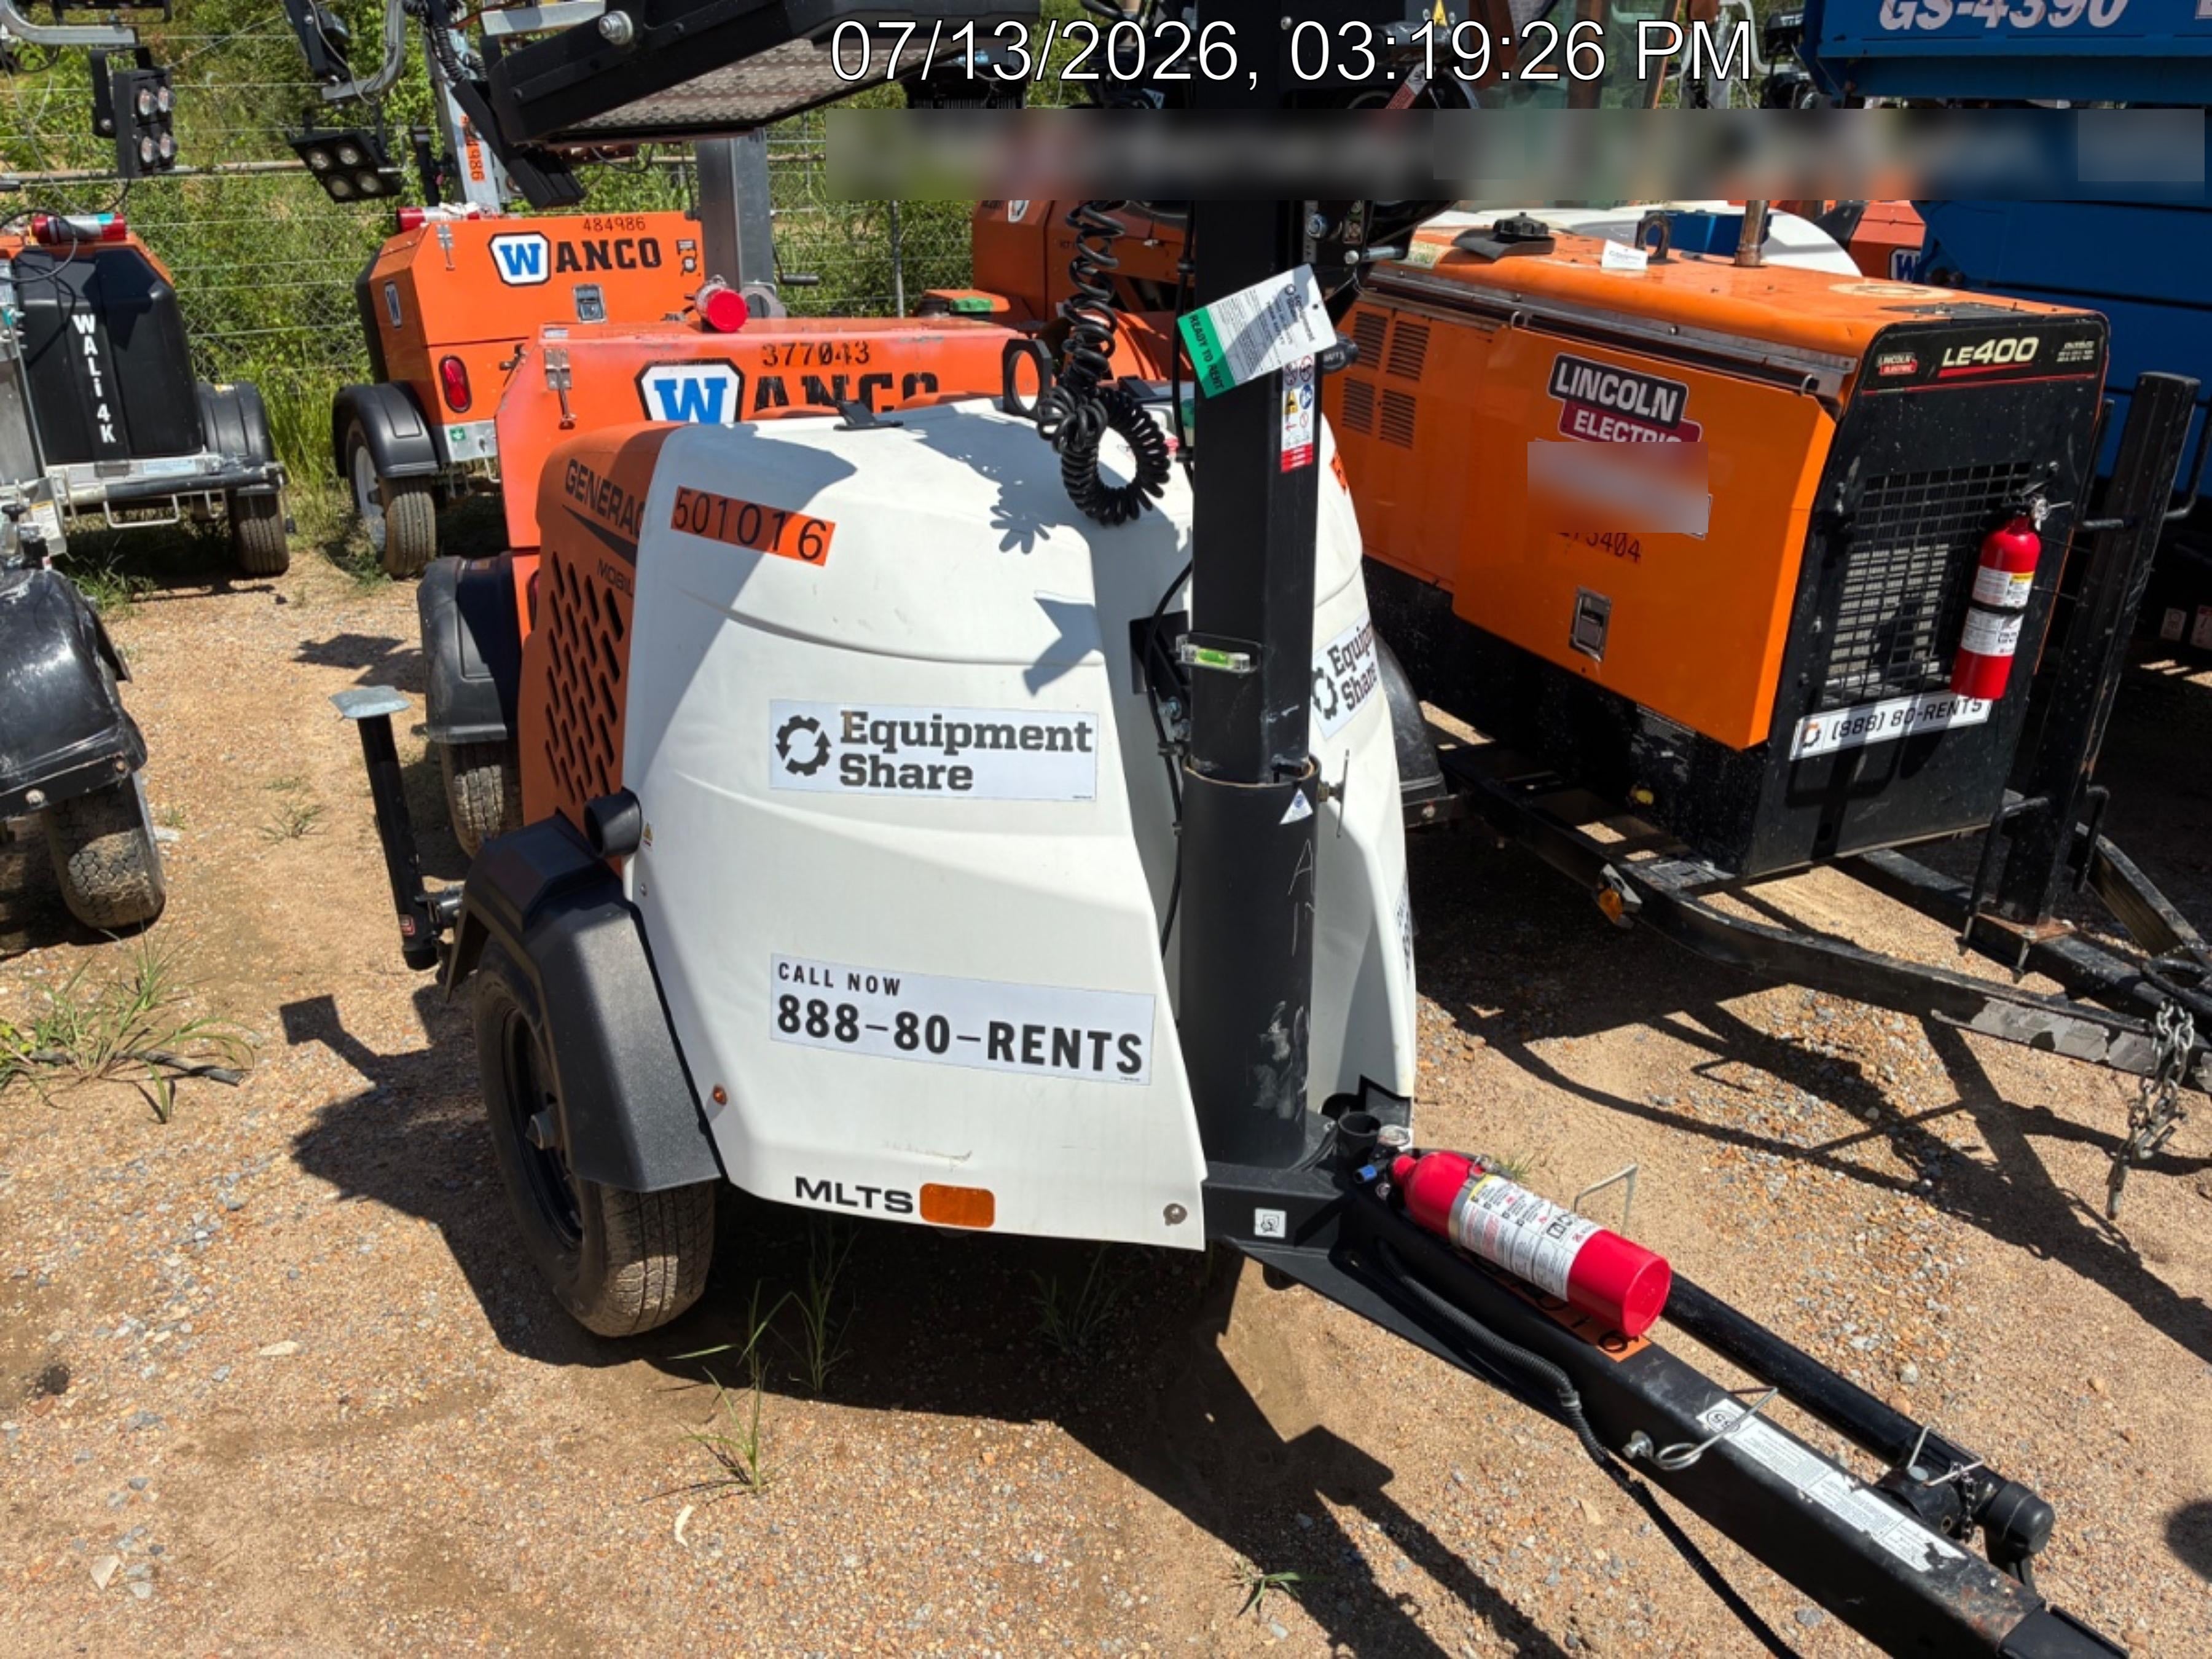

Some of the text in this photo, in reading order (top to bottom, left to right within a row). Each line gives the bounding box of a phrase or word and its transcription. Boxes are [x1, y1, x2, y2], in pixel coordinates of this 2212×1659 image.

[582, 216, 646, 232] 484986
[499, 237, 662, 275] WANCO
[762, 341, 870, 367] 377043
[1189, 315, 1225, 390] READY TO RENT
[1942, 337, 2040, 367] LE400
[1555, 362, 1678, 422] LINCOLN
[675, 491, 827, 561] 501016
[840, 710, 1093, 756] Equipment
[1832, 699, 1982, 740] (888) 80-RENTS
[839, 753, 973, 791] Share
[778, 962, 901, 997] CALL NOW
[777, 994, 1143, 1075] 888-80-RENTS
[794, 1175, 914, 1214] MLTS
